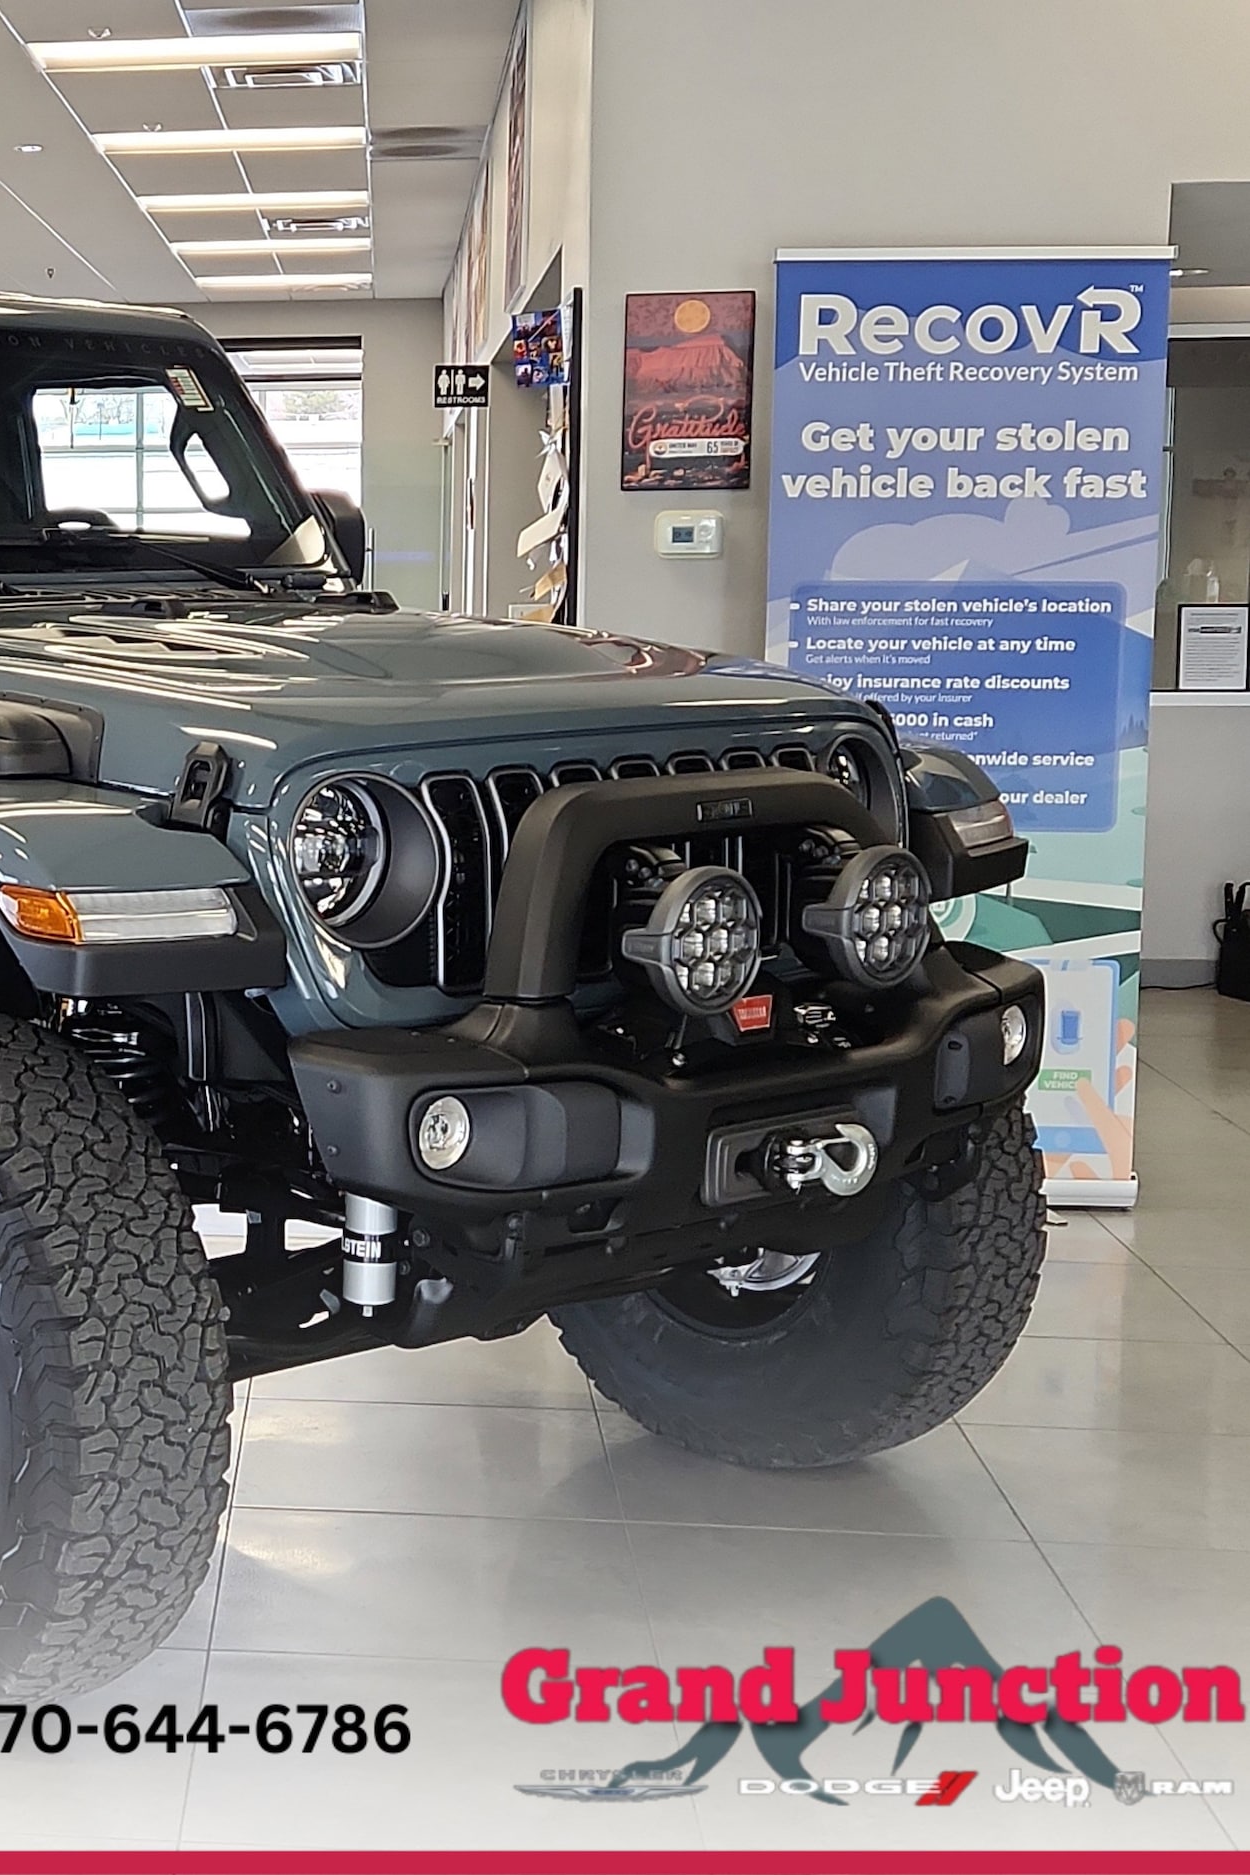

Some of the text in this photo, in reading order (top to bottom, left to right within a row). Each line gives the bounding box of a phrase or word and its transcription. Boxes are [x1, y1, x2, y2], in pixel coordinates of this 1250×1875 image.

[798, 285, 1142, 356] RecovR
[799, 361, 1138, 385] Vehicle Theft Recovery System
[436, 396, 485, 405] RESTROOMS
[628, 396, 746, 449] Gratitude
[801, 420, 1129, 458] Get your stolen
[706, 441, 719, 454] 65
[782, 465, 1148, 498] vehicle back fast
[807, 598, 1111, 614] Share your stolen vehicle's location
[807, 616, 994, 628] With law enforcement for fast recovery
[806, 636, 1076, 654] Locate your vehicle at any time
[805, 654, 931, 664] Get alerts when it's moved
[857, 673, 941, 689] insurance
[946, 676, 980, 689] rate
[984, 674, 1070, 690] discounts
[863, 692, 899, 701] offered
[901, 692, 912, 703] by
[914, 694, 936, 703] your
[938, 692, 972, 702] insurer
[933, 711, 949, 727] in
[953, 712, 994, 727] cash
[1032, 751, 1094, 767] service
[1033, 790, 1088, 804] dealer
[1053, 1071, 1079, 1080] FIND
[1044, 1080, 1076, 1089] VEHIC
